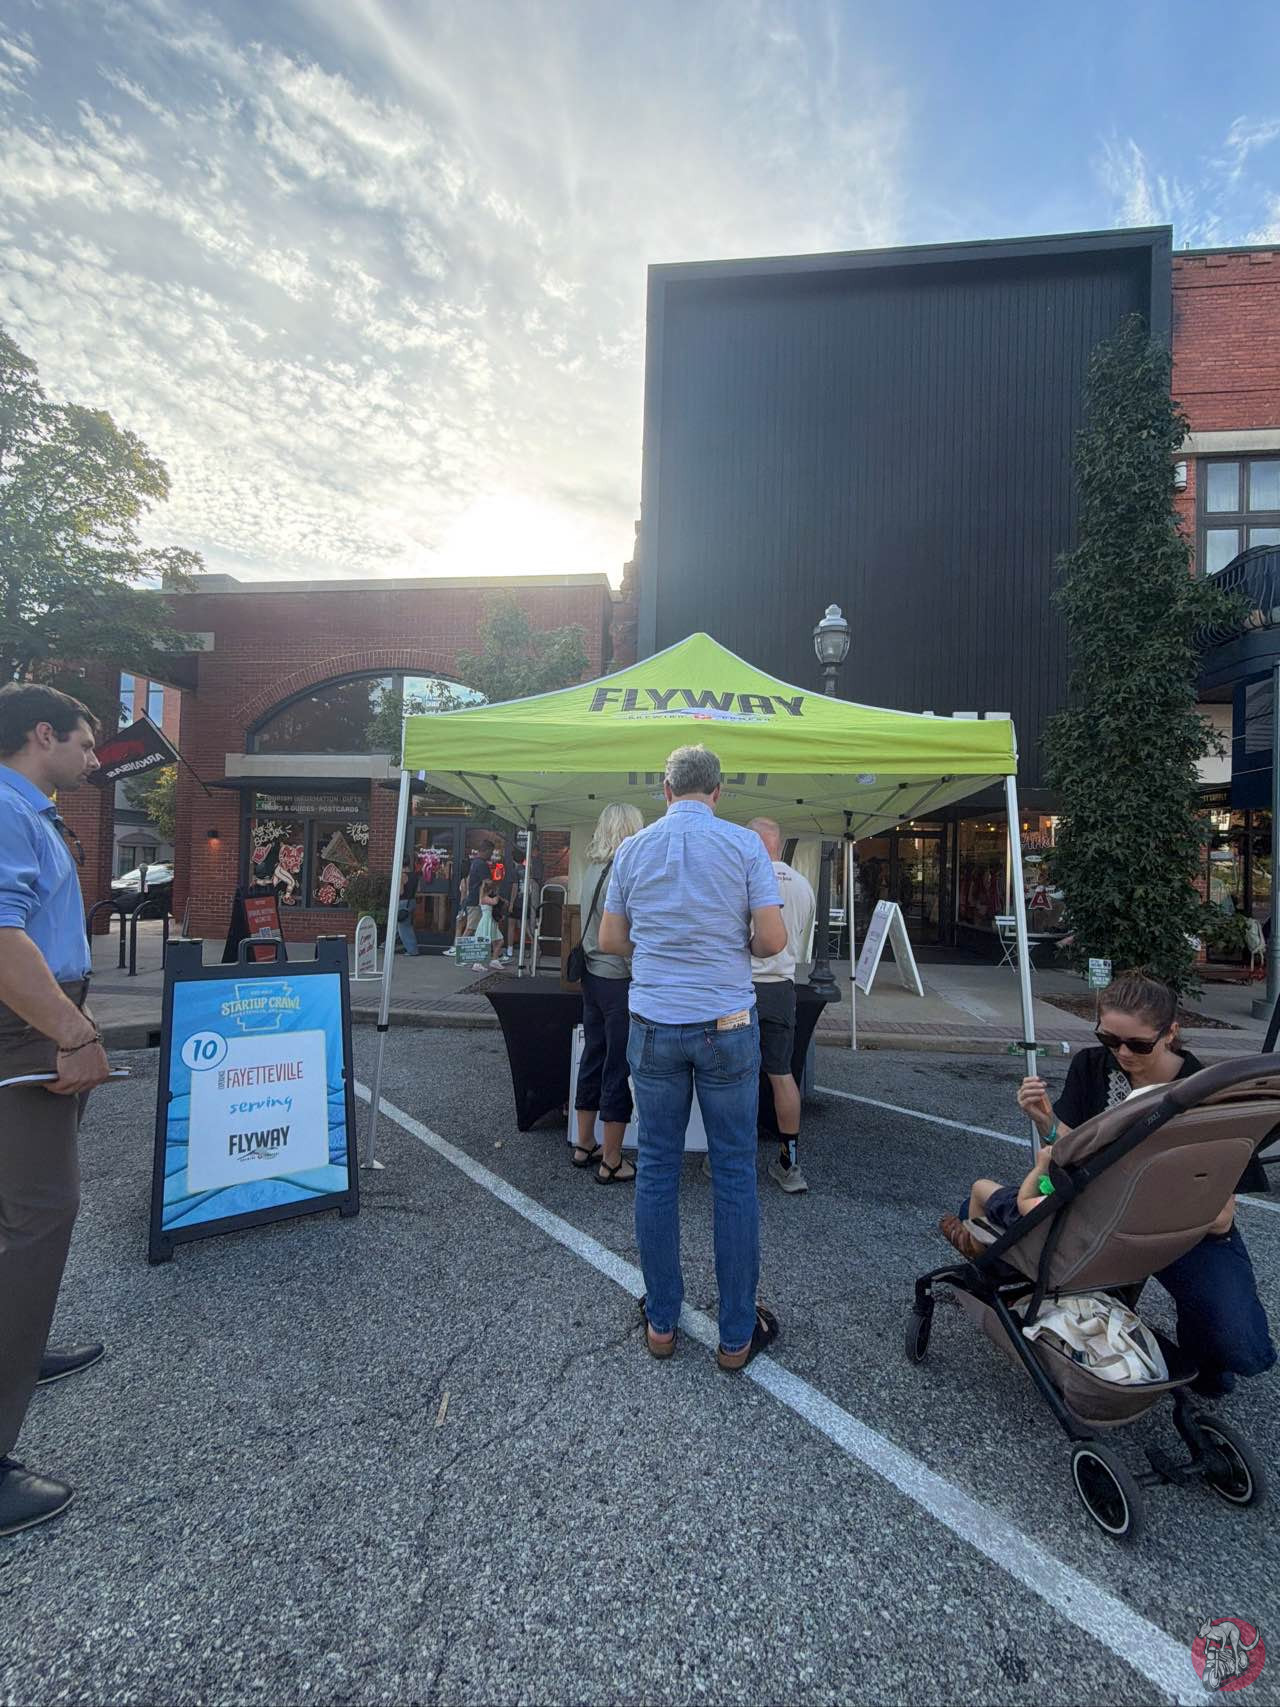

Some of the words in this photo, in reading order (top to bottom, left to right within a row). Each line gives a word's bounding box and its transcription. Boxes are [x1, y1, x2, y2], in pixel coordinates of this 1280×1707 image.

[588, 687, 805, 717] FLYWAY
[318, 804, 359, 813] POSTCARDS
[221, 996, 268, 1016] STARTUP
[268, 994, 301, 1010] CRAWL
[193, 1039, 218, 1062] 10
[226, 1061, 304, 1089] FAYETTEVILLE
[229, 1095, 293, 1115] serving
[228, 1124, 290, 1156] FLYWAY
